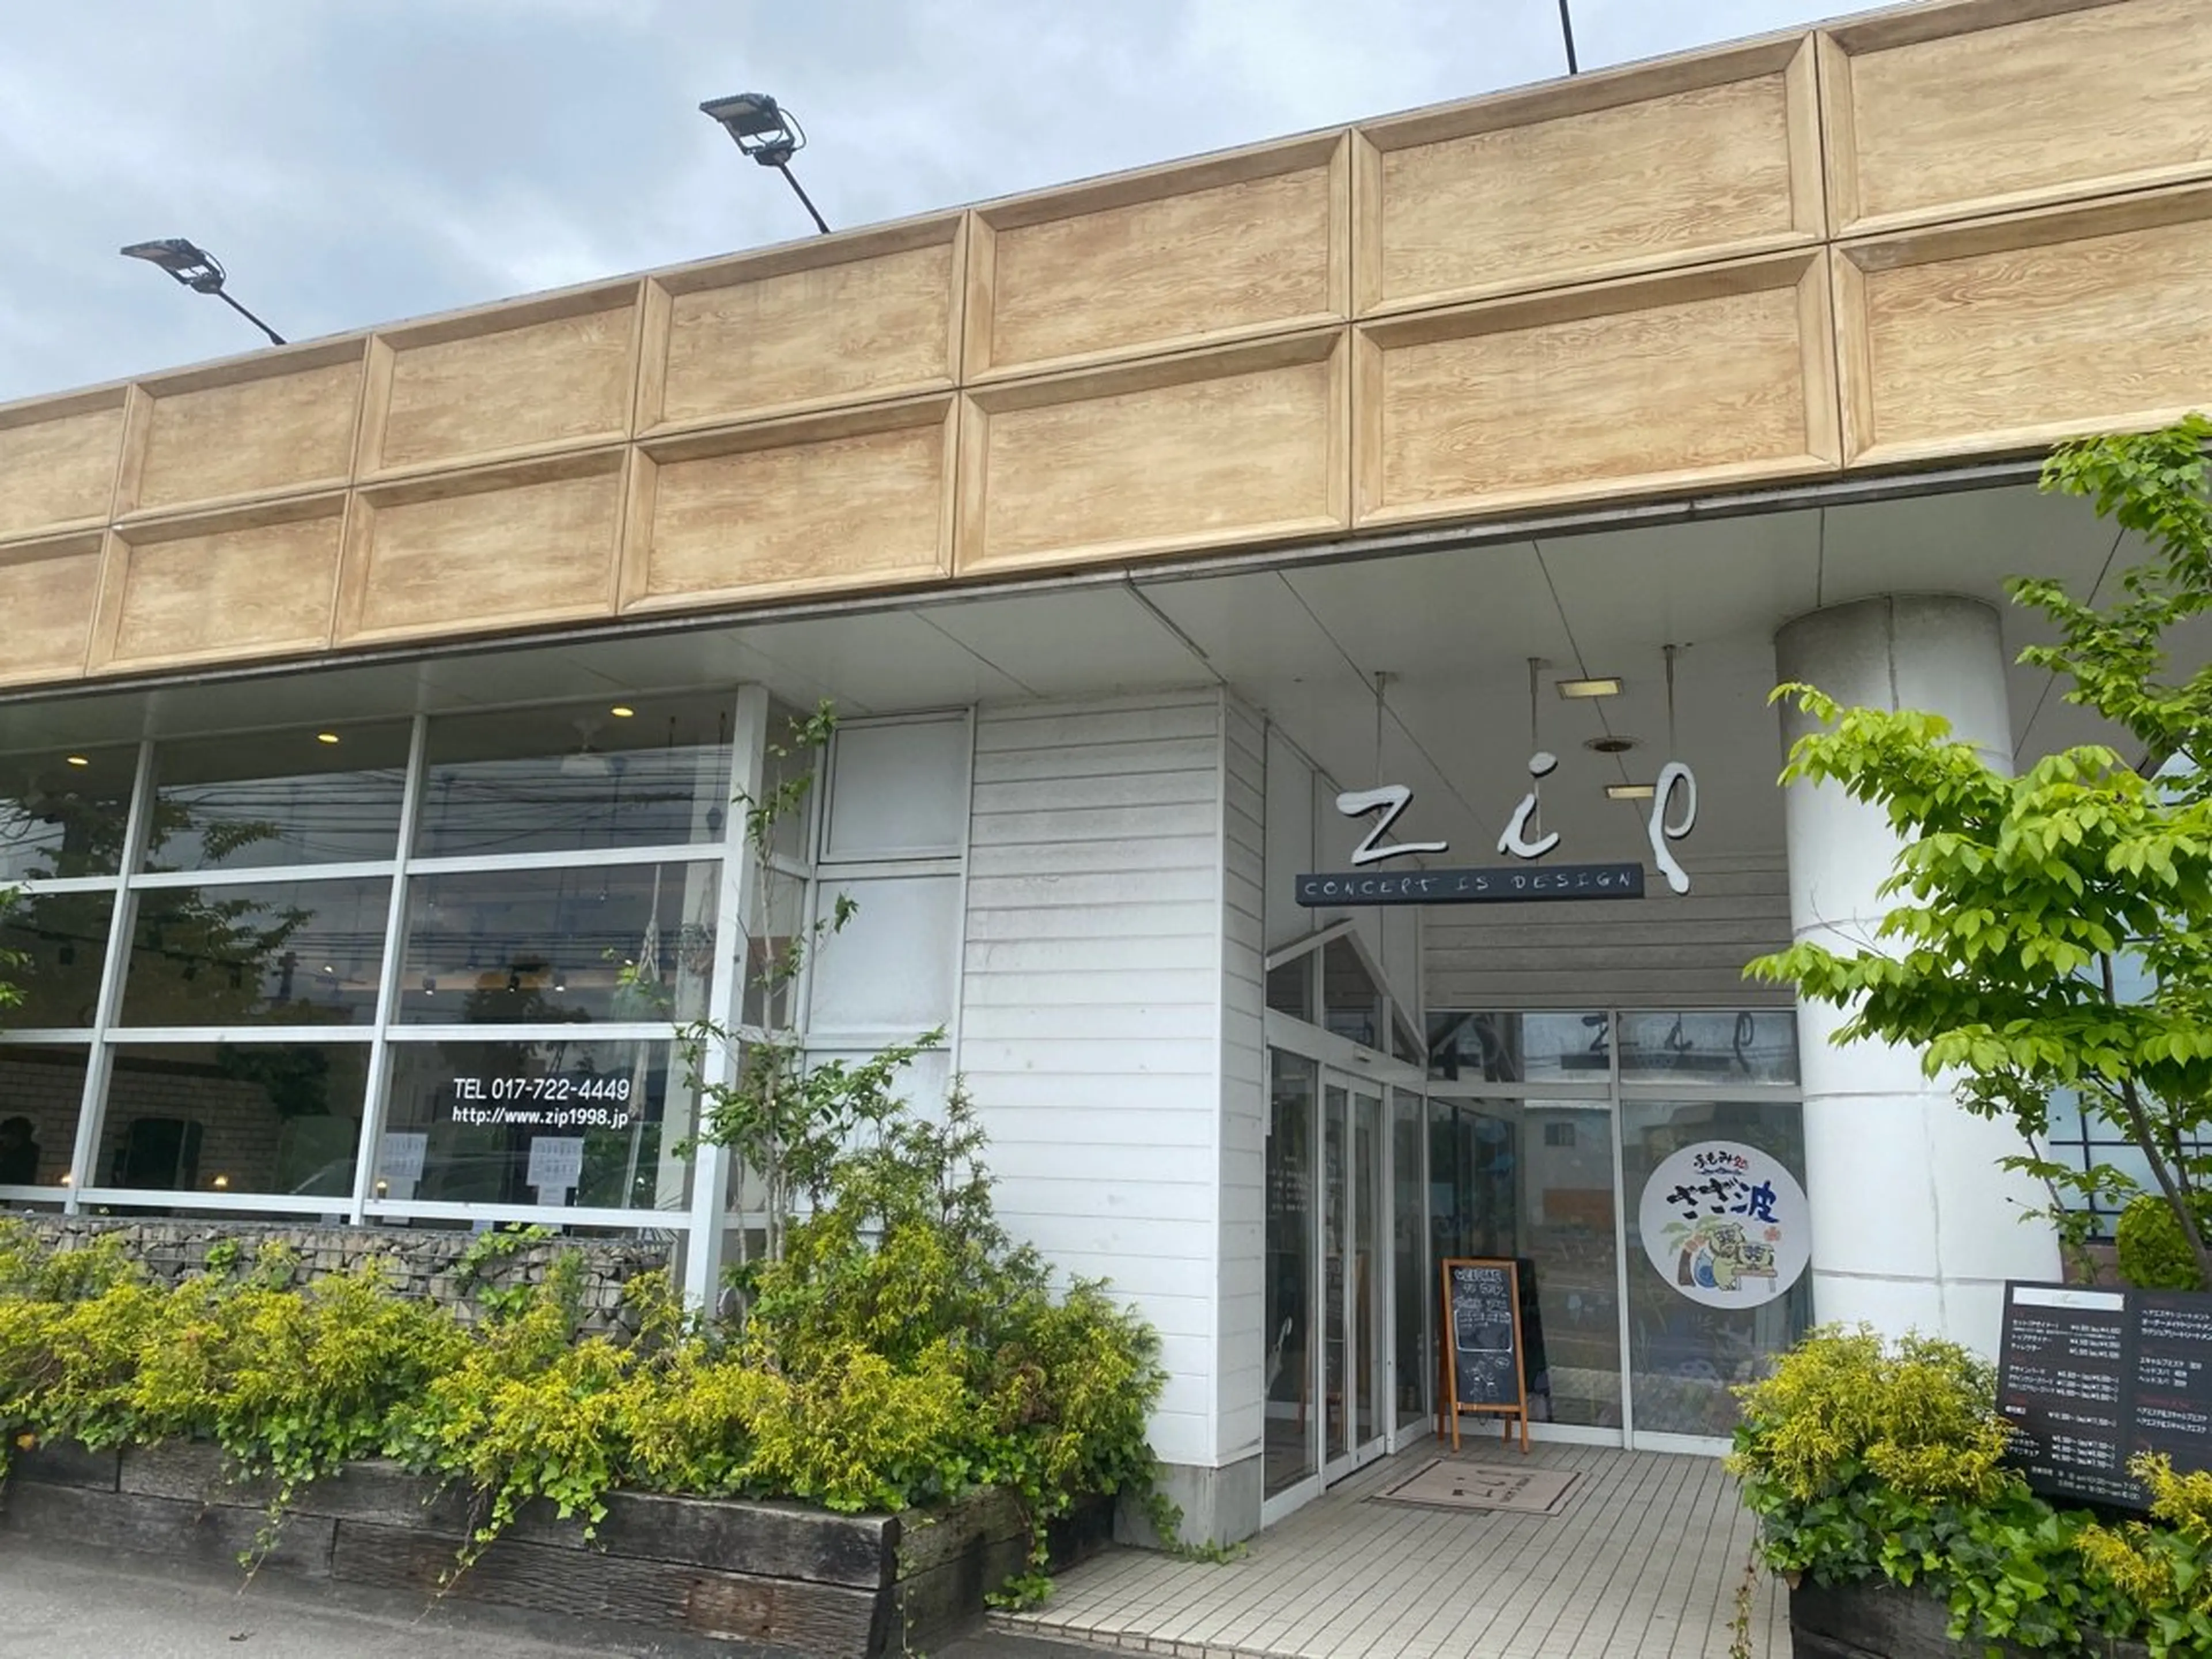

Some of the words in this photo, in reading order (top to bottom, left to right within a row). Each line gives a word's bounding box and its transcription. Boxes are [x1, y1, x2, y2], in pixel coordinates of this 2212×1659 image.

[1335, 751, 1698, 895] zip
[1512, 872, 1631, 889] DESIGN
[453, 1078, 487, 1099] TEL
[491, 1078, 630, 1101] 017-722-4449
[452, 1105, 629, 1130] http://www.zip1998.jp
